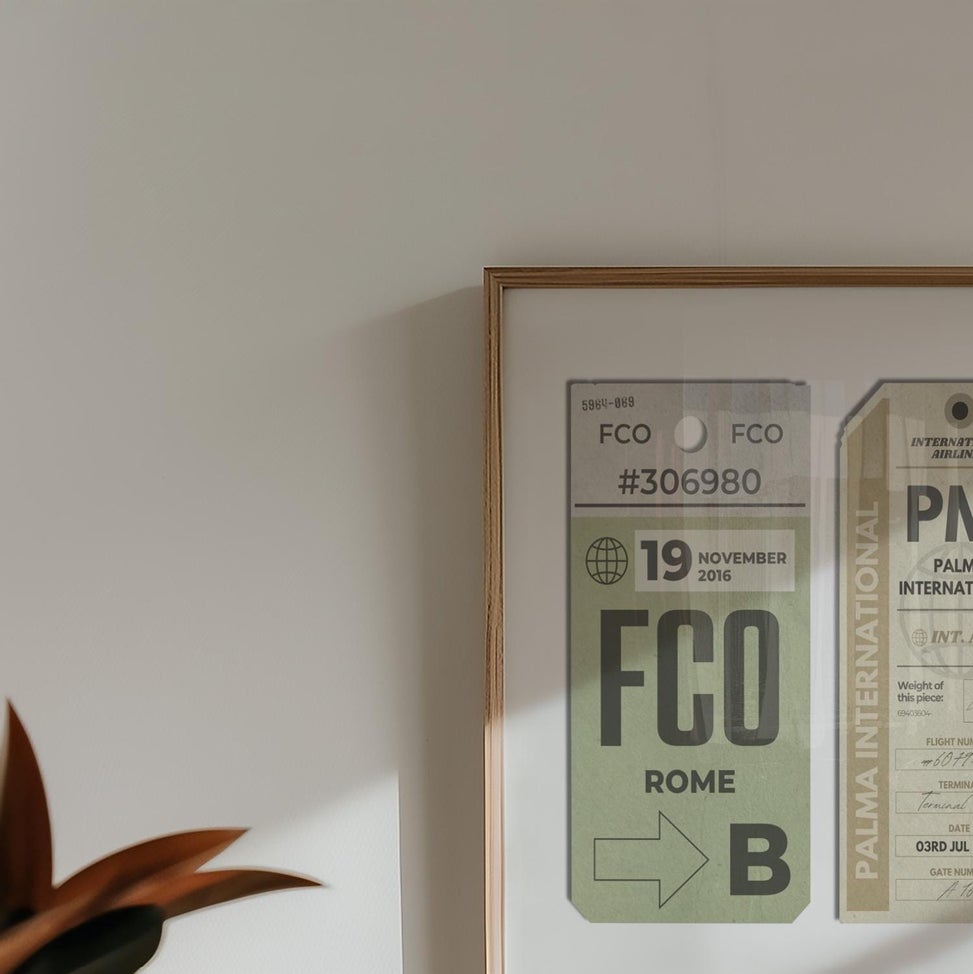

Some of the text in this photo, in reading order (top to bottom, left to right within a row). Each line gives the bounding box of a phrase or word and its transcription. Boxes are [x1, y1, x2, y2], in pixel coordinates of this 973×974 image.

[600, 424, 651, 444] FCO
[731, 424, 784, 444] FCO
[618, 468, 762, 495] #306980
[640, 539, 692, 581] 19
[698, 552, 786, 564] NOVEMBER
[698, 569, 731, 582] 2016
[931, 630, 964, 643] INT.
[600, 609, 779, 746] FCO
[855, 501, 879, 880] PALMA INTERNATIONAL
[897, 681, 944, 692] Weight of
[897, 693, 944, 704] this piece:
[926, 738, 955, 746] FLIGHT
[645, 770, 736, 793] ROME
[948, 824, 971, 832] DATE
[916, 841, 947, 852] 03RD
[949, 841, 969, 852] JUL
[730, 823, 791, 895] B
[930, 868, 952, 876] GATE
